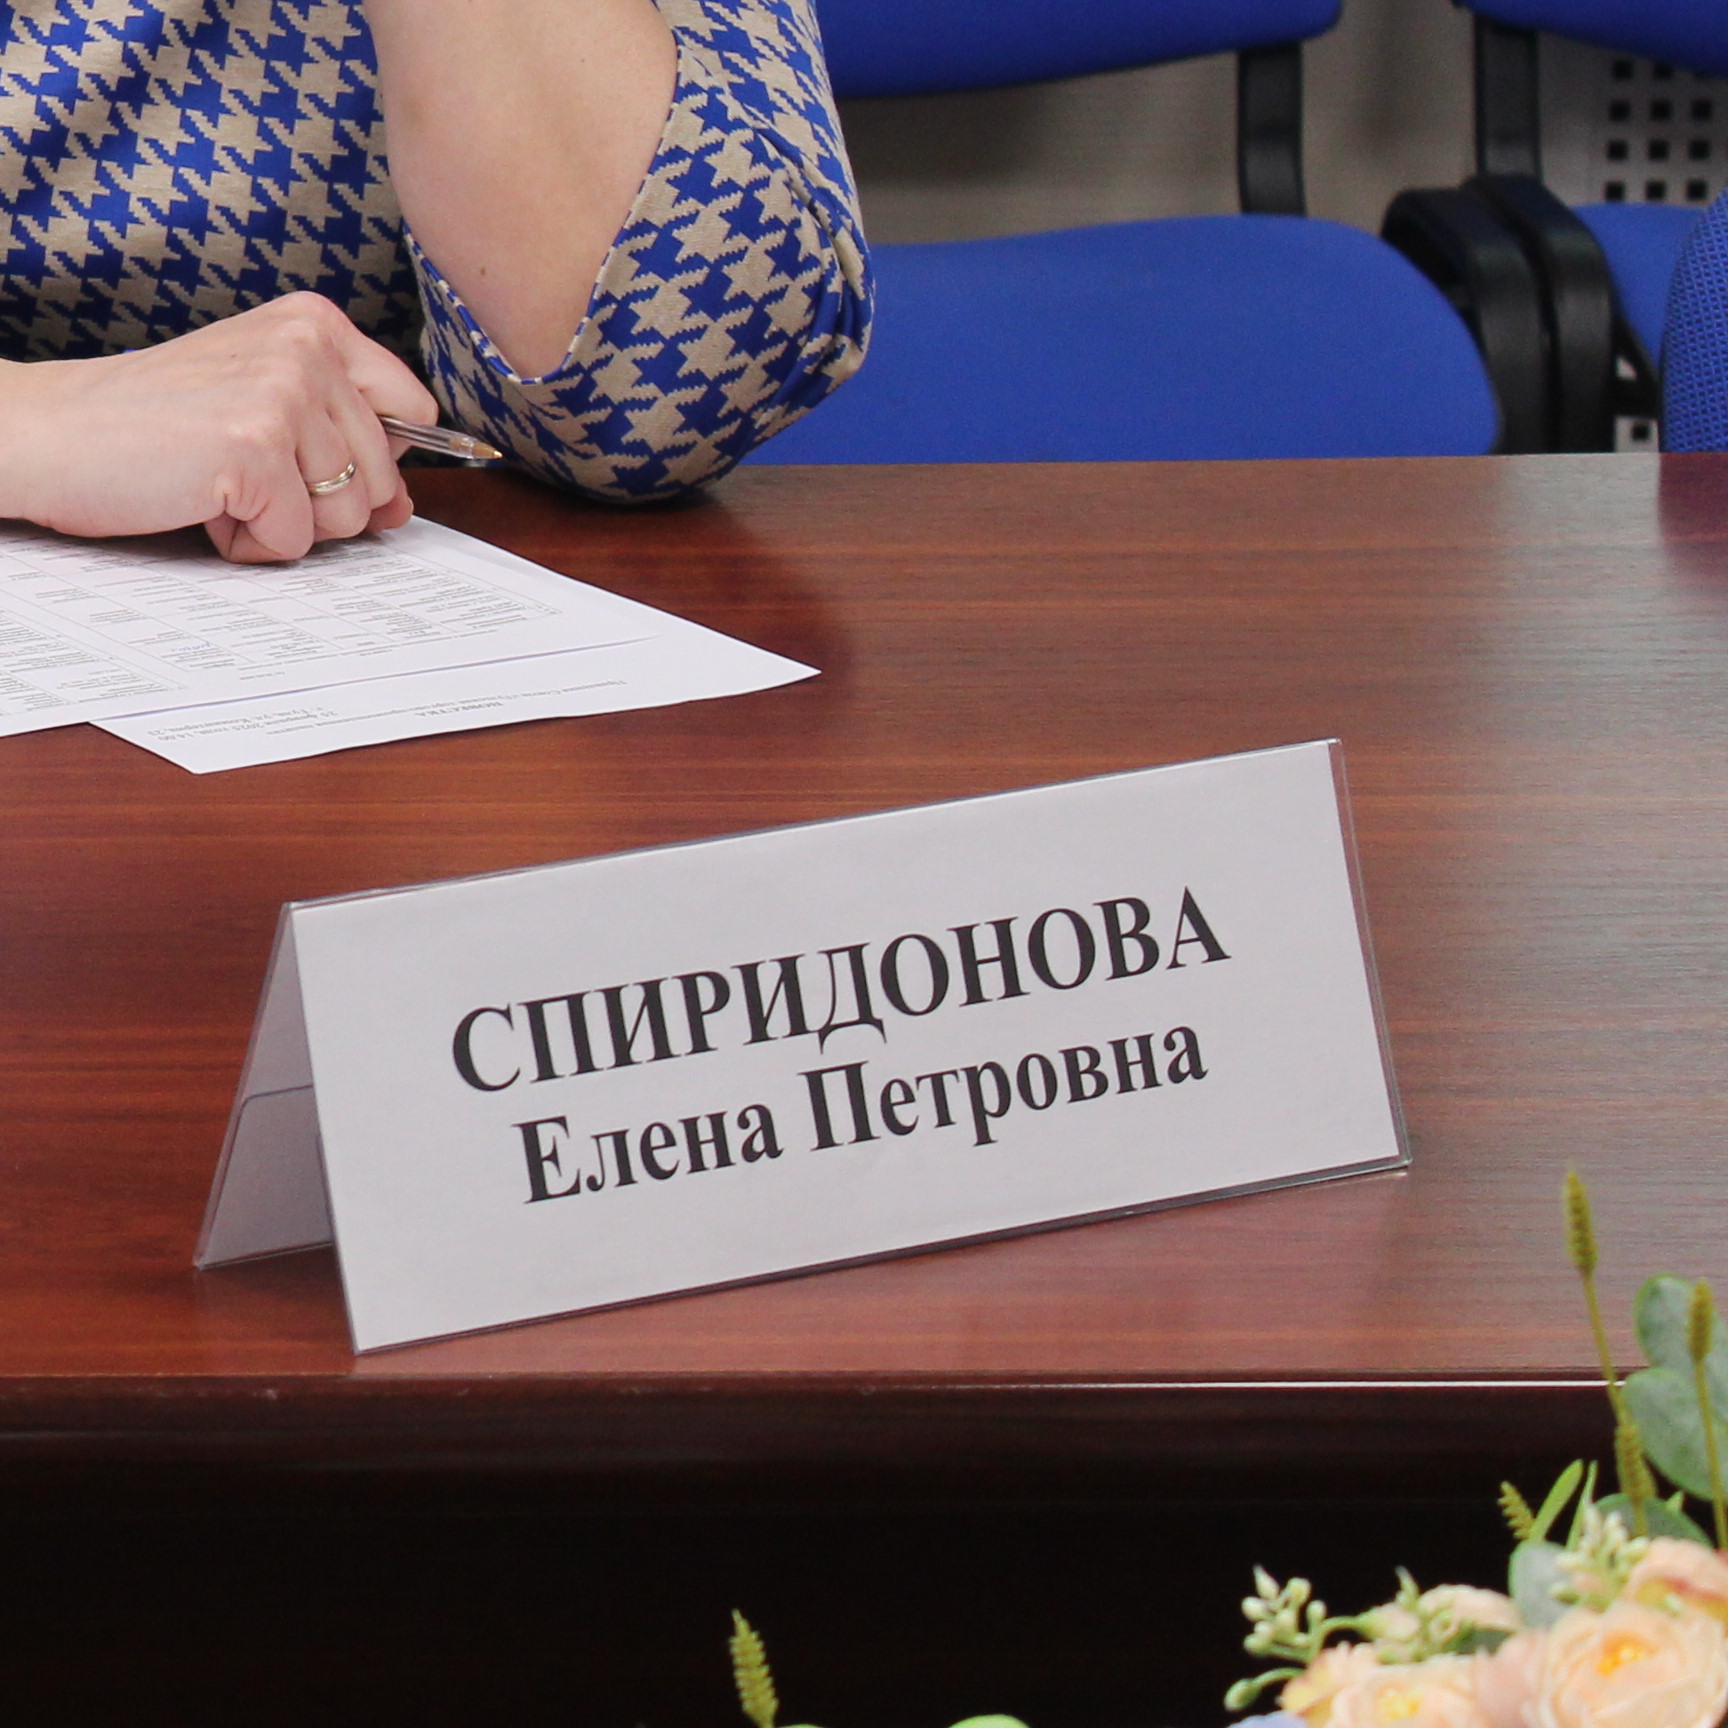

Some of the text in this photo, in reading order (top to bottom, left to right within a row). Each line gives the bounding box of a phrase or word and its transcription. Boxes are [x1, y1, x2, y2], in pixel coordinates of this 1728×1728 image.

[451, 885, 1232, 1093] СПИРИДОНОВА
[511, 1026, 1209, 1205] Елена Петровна
